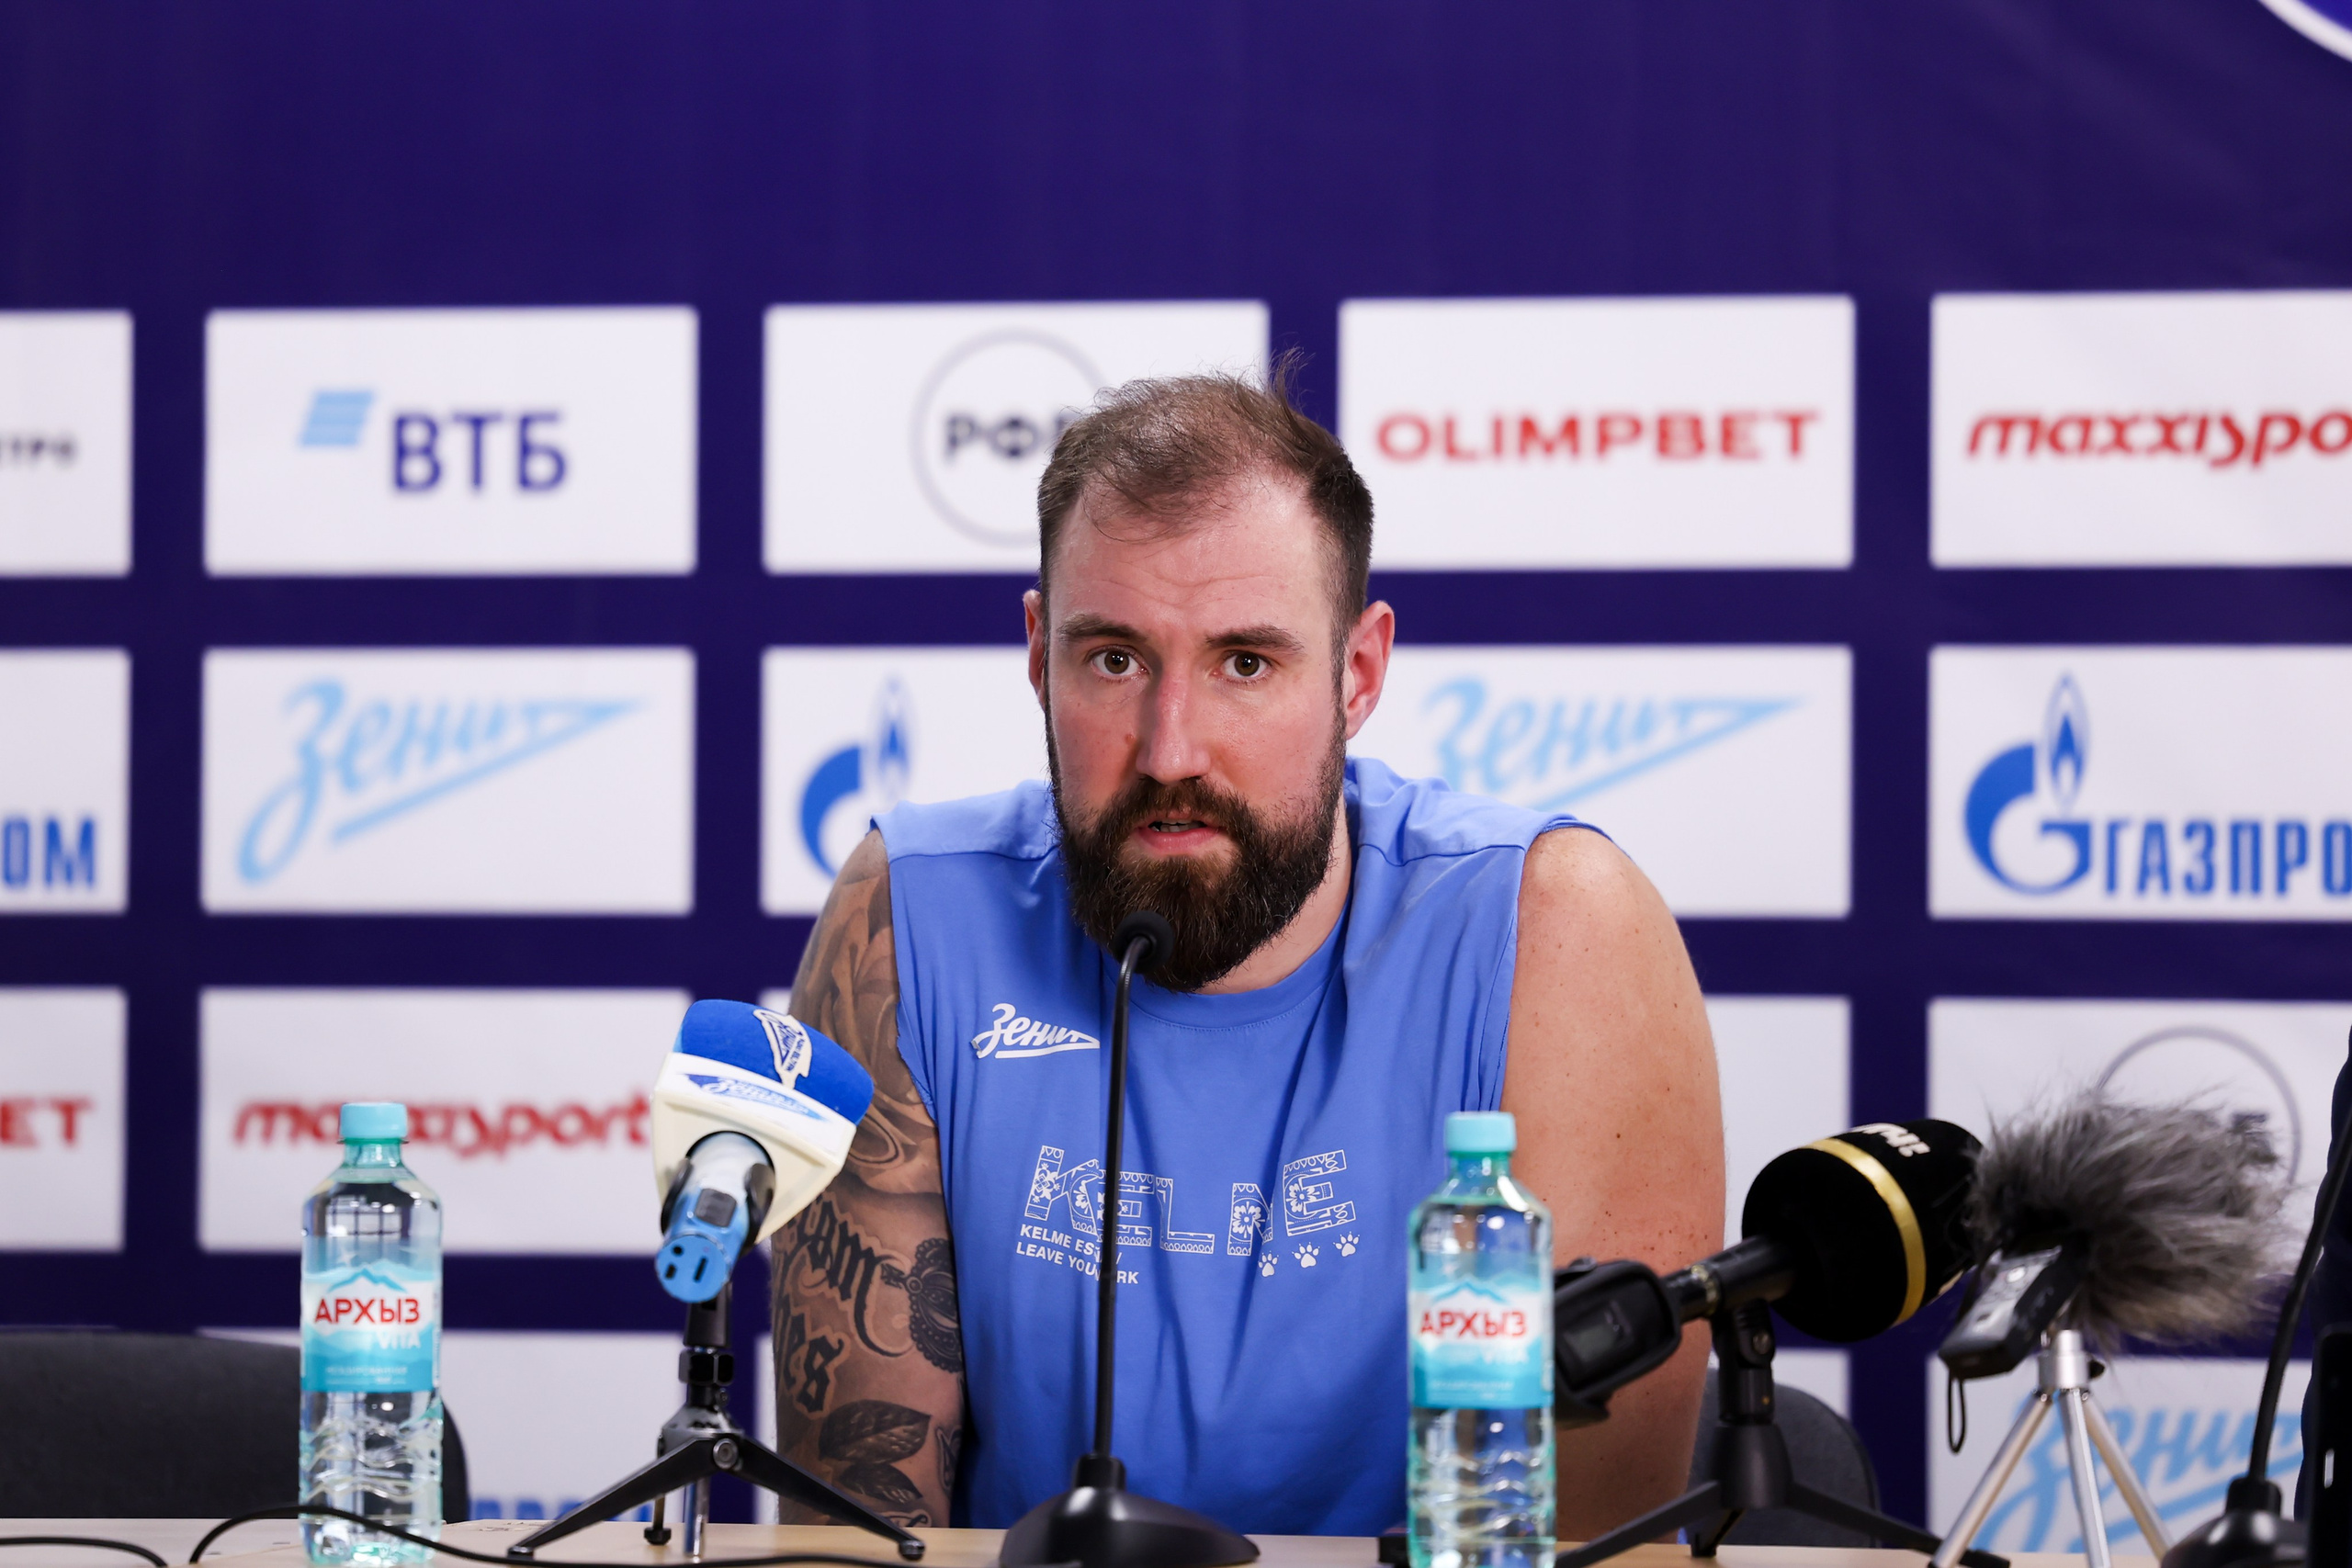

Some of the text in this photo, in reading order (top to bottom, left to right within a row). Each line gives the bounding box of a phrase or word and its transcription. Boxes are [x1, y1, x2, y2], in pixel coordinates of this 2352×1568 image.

[392, 412, 567, 492] ВТБ
[946, 414, 1077, 462] РФ
[1377, 412, 1818, 461] OLIMPBET
[1425, 677, 1806, 812] Зенит
[237, 678, 645, 886] Зенит
[2106, 820, 2352, 896] ГАЗПРО
[971, 1003, 1101, 1059] Зенит
[0, 1097, 96, 1148] ET
[1016, 1242, 1065, 1265] LEAVE
[1068, 1255, 1097, 1276] YOU
[1019, 1224, 1072, 1249] KELME
[314, 1298, 420, 1324] АРХЫЗ
[1419, 1311, 1527, 1337] АРХЫЗ
